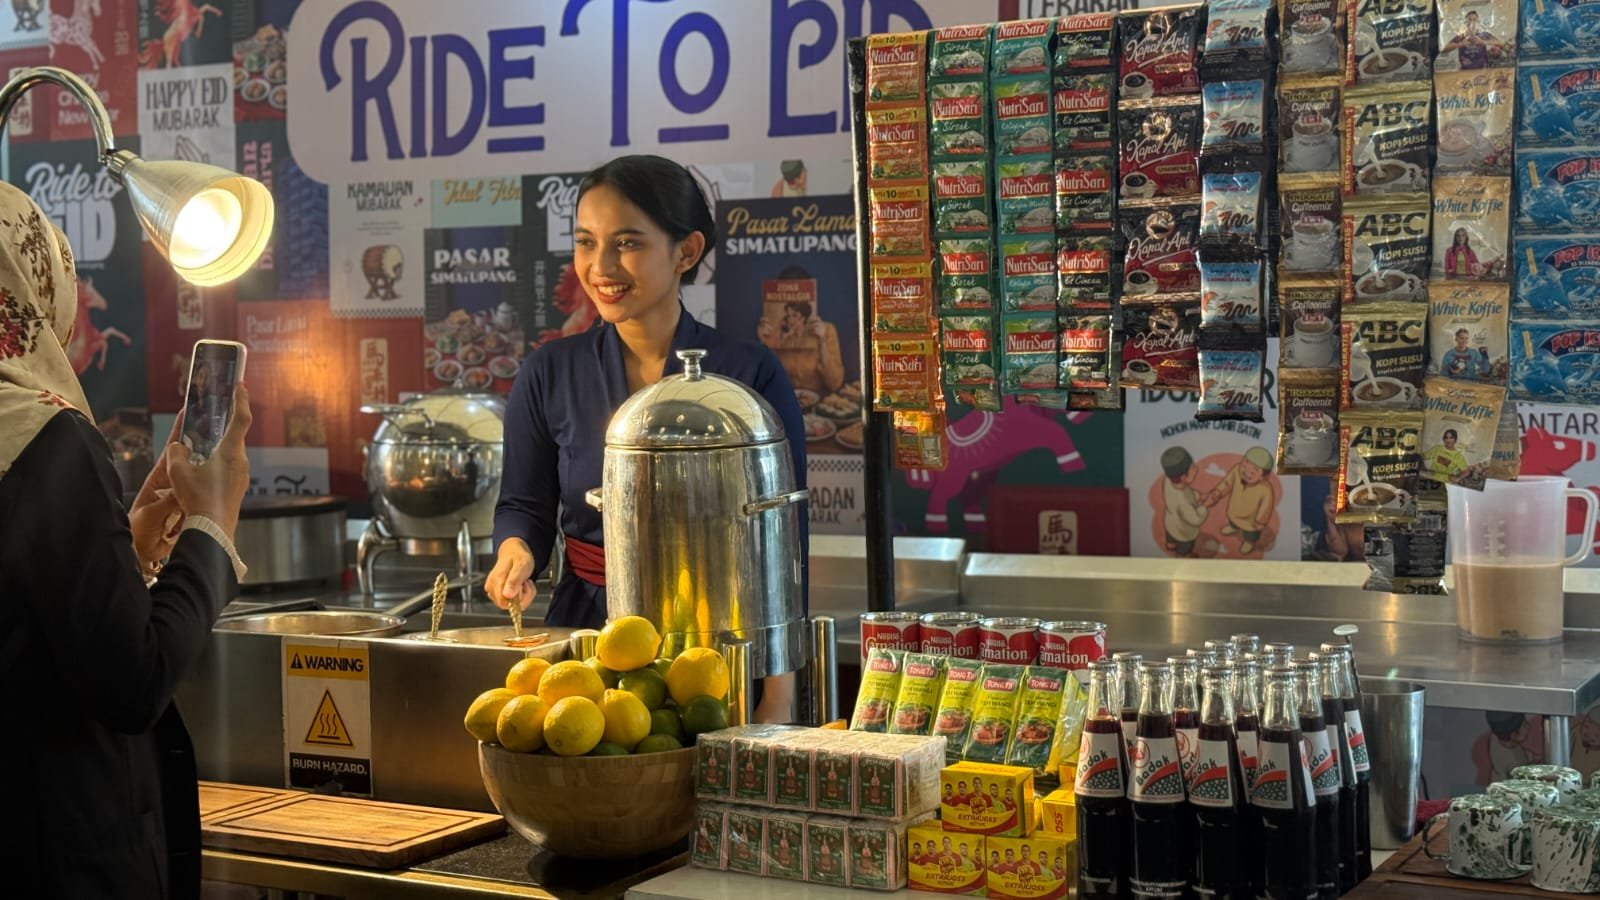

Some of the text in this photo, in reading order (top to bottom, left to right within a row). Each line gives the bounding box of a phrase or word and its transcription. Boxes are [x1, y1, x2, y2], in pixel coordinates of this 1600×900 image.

[1380, 22, 1430, 40] KOPI SUSU
[1163, 31, 1187, 54] Api
[319, 0, 546, 162] RIDE
[1558, 71, 1591, 94] POP
[146, 74, 229, 111] HAPPY EID
[1440, 93, 1470, 111] White
[935, 100, 979, 117] NutriSari
[1356, 101, 1428, 127] ABC
[153, 106, 219, 132] MUBARAK
[1163, 132, 1188, 156] Api
[1379, 133, 1428, 151] KOPI SUSU
[1556, 159, 1588, 182] POP
[25, 161, 92, 214] Ride
[937, 178, 981, 195] NutriSari
[1434, 198, 1505, 215] White Koffie
[727, 206, 790, 235] Pasar
[1354, 212, 1426, 237] ABC
[1166, 230, 1192, 253] Api
[434, 247, 511, 269] PASAR
[945, 255, 984, 271] NutriSari
[1379, 245, 1427, 262] KOPI SUSU
[1553, 245, 1600, 269] POP IC
[430, 270, 517, 284] SIMATUPANG
[1431, 301, 1503, 320] White Koffie
[946, 333, 988, 349] NutriSari
[1167, 328, 1195, 350] Api
[1352, 320, 1422, 344] ABC
[1551, 331, 1600, 354] POP IC
[1376, 353, 1424, 367] KOPI SUSU
[1425, 397, 1495, 420] White Koffie
[1351, 426, 1419, 450] ABC
[1373, 461, 1419, 475] KOPI SUSU
[808, 486, 855, 509] ADAN
[809, 508, 841, 524] ARAK
[304, 654, 364, 672] WARNING
[909, 666, 927, 674] TONG
[949, 669, 967, 678] TONG
[986, 680, 1004, 688] TONG
[1030, 680, 1049, 688] TONG
[292, 757, 321, 770] BURN
[1077, 750, 1108, 779] Badak
[1135, 754, 1171, 786] Badak
[1196, 757, 1218, 775] dak
[1257, 759, 1277, 776] dak
